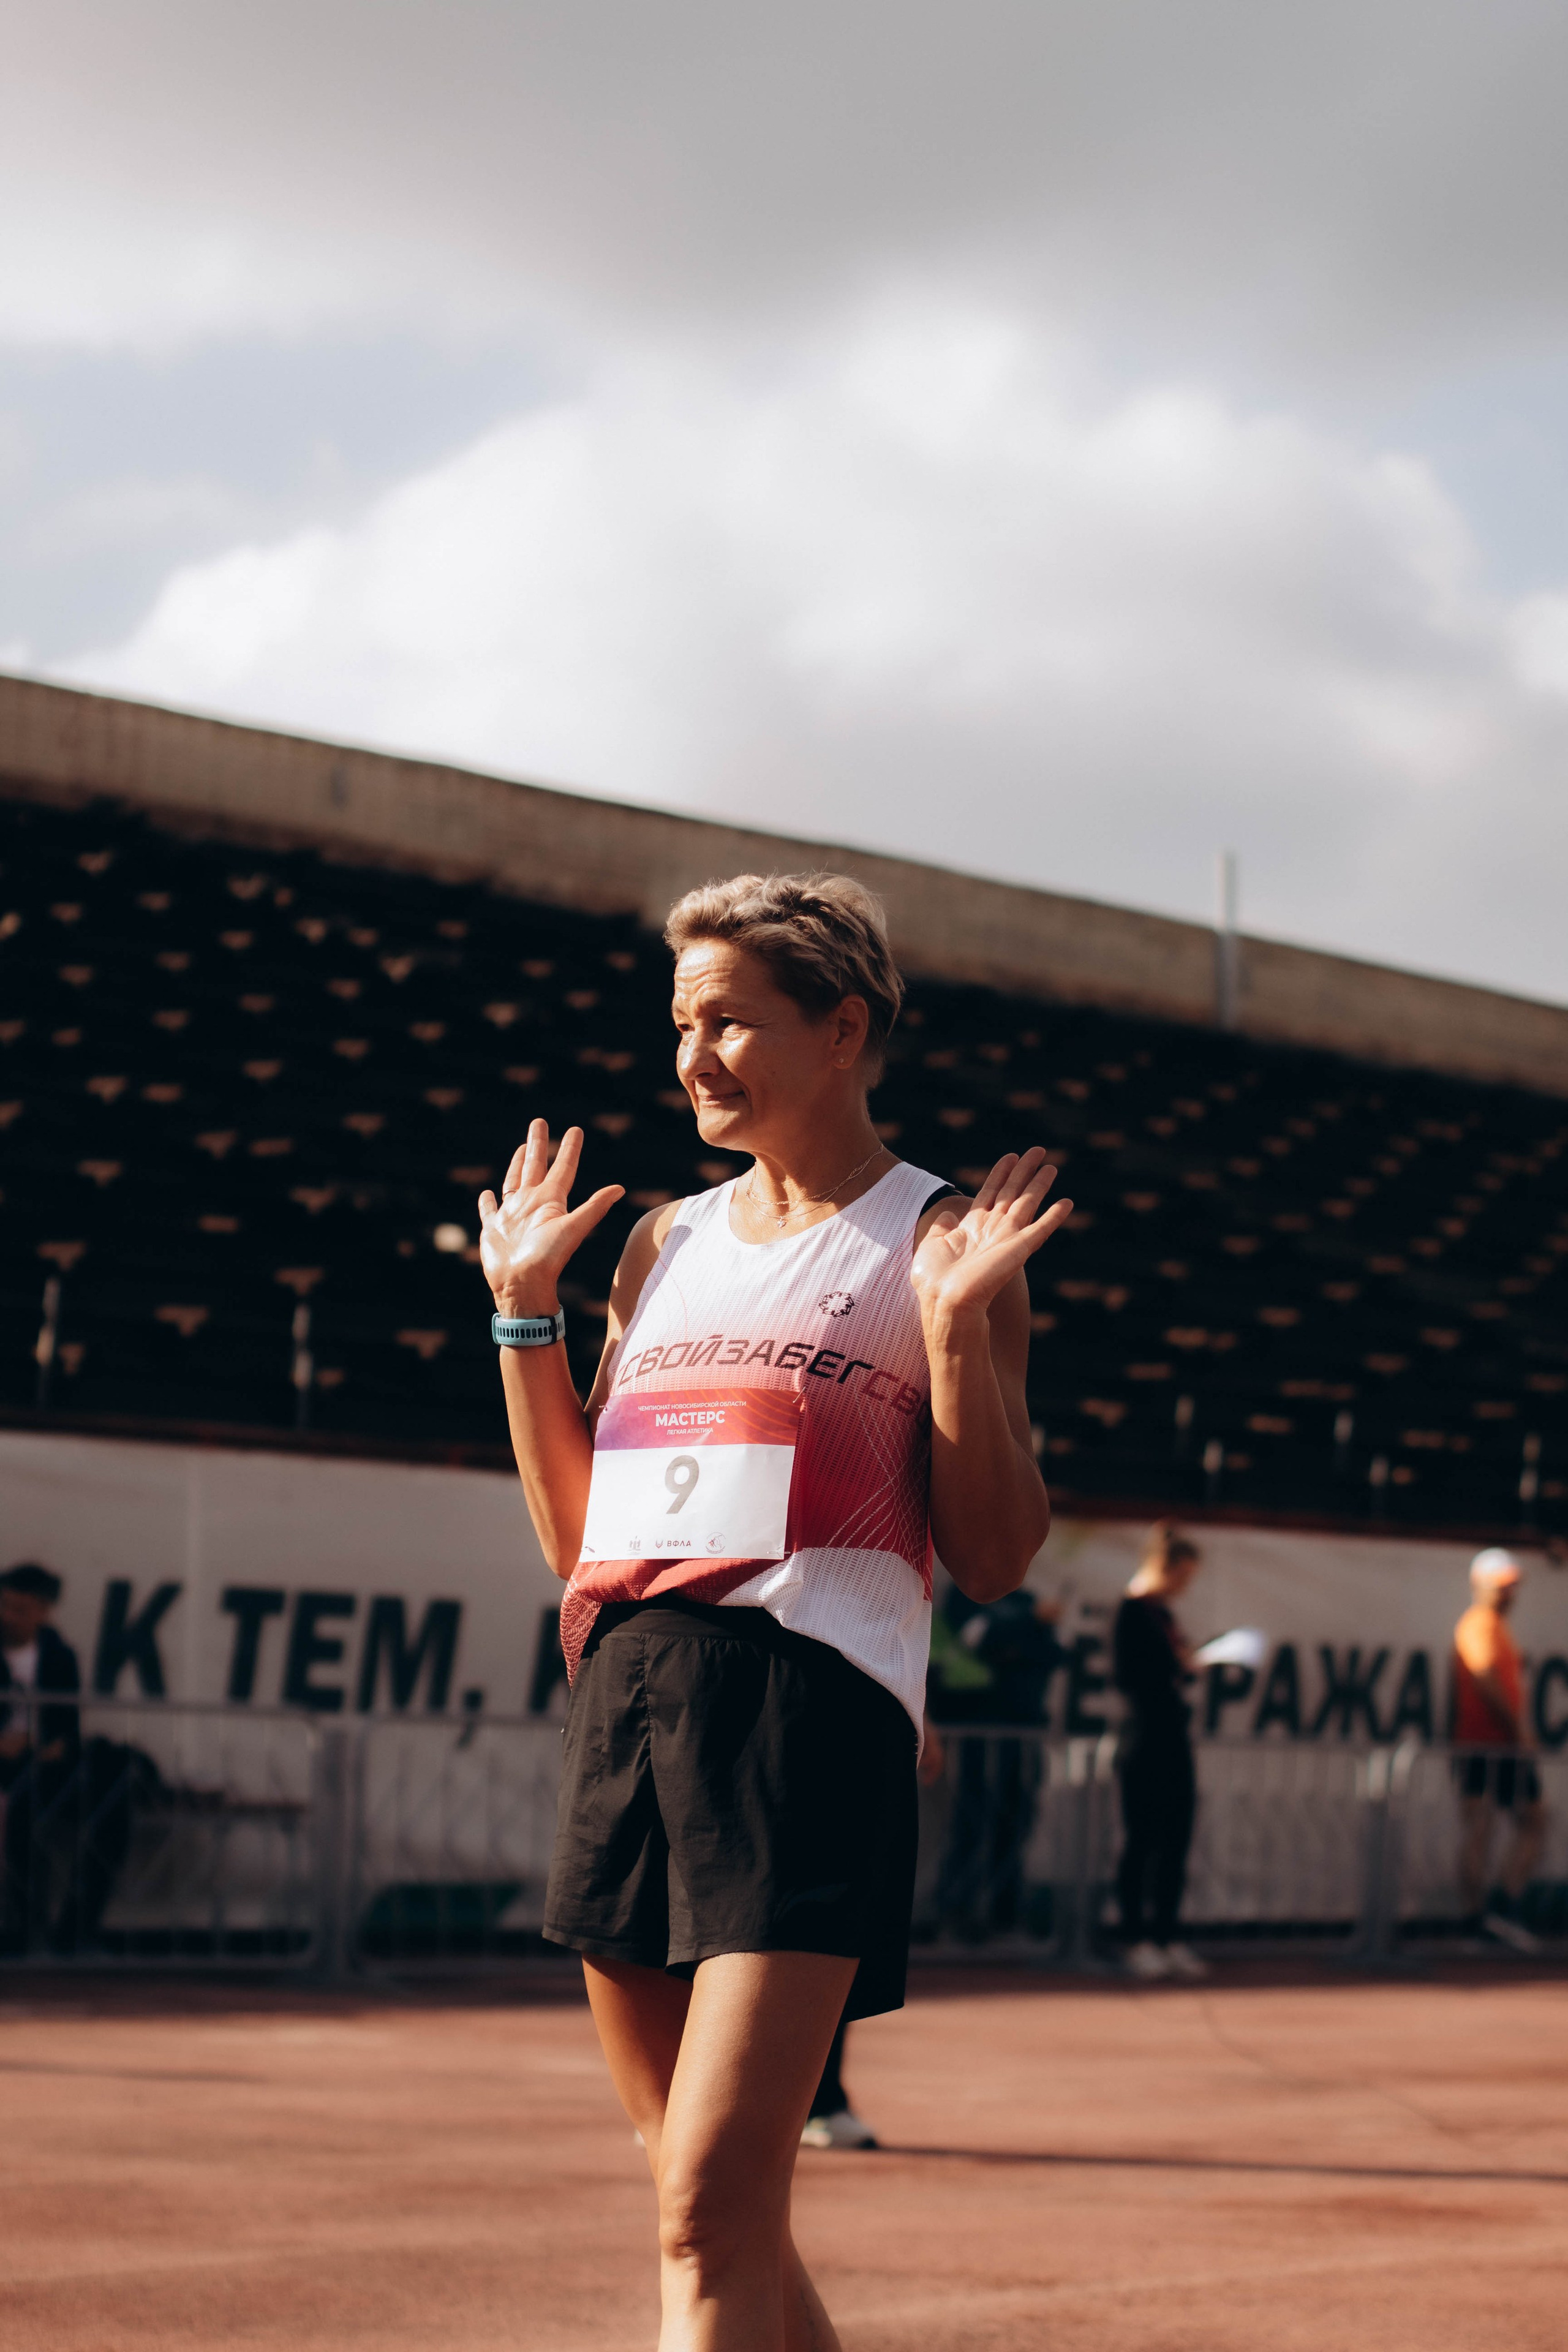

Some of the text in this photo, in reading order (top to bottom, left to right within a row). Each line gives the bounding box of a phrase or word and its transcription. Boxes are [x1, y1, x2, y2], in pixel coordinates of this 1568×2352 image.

[655, 1410, 725, 1427] МАСТЕРС
[671, 1401, 719, 1409] НОВОСИБИРСКОЙ
[664, 1455, 700, 1515] 9
[92, 1579, 183, 1698] К
